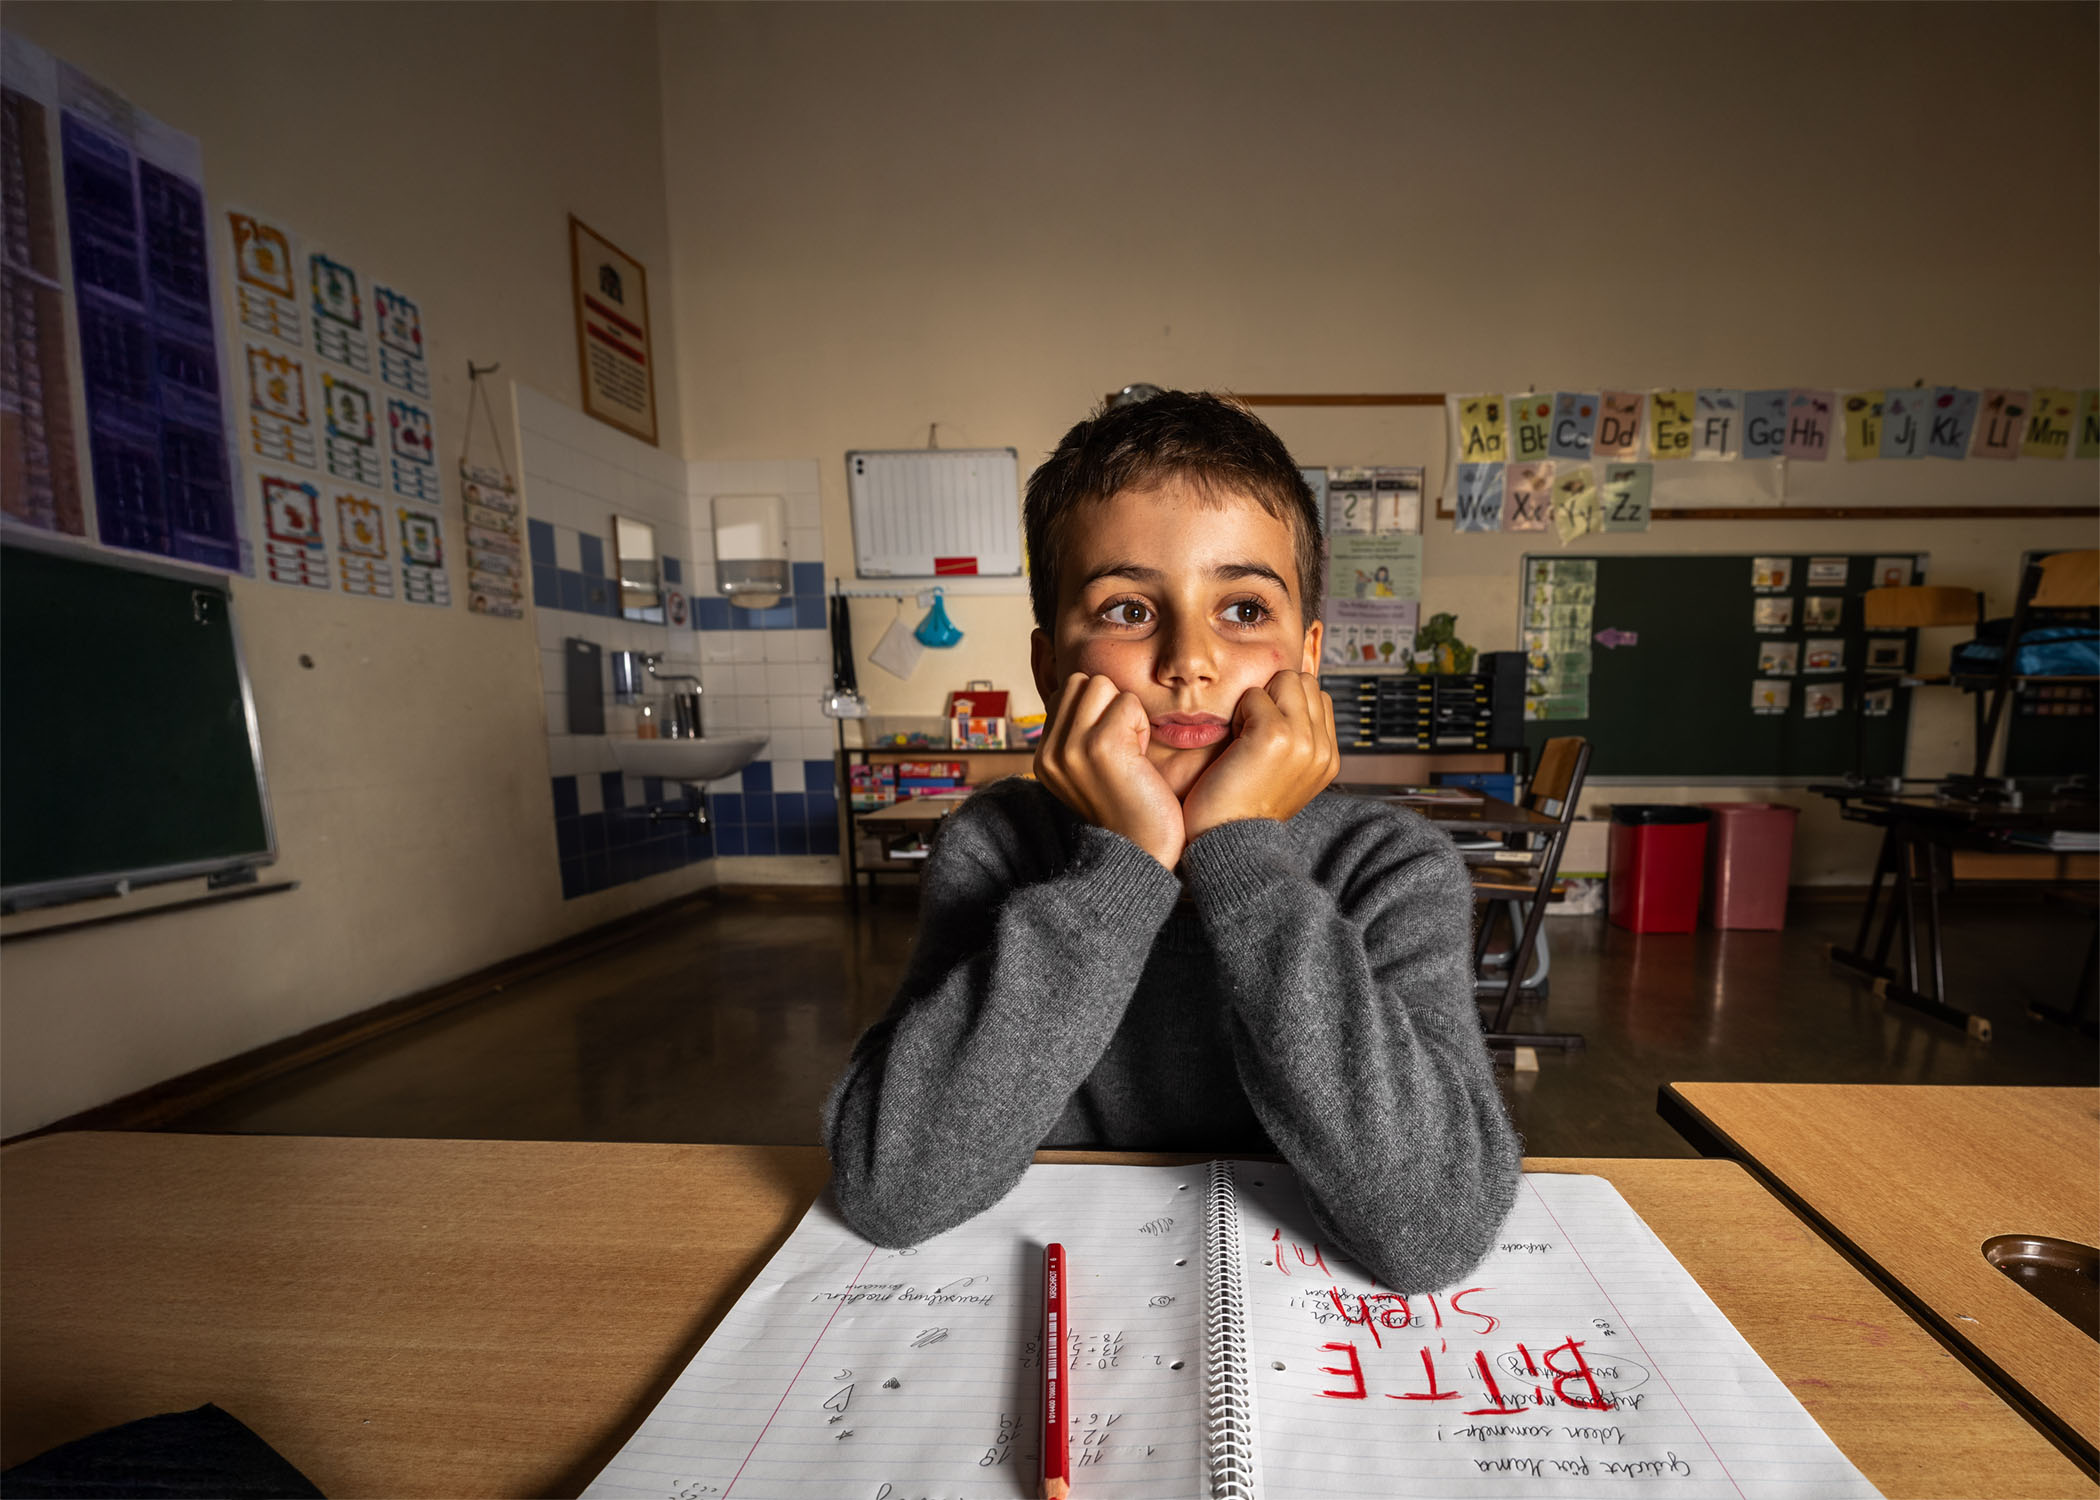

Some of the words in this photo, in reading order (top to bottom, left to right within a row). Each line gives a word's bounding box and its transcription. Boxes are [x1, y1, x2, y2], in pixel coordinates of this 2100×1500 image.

[1467, 424, 1500, 454] Aa
[1556, 419, 1590, 450] Cc
[1600, 417, 1636, 447] Dd
[1657, 420, 1689, 450] Ee
[1704, 417, 1731, 455] Ff
[1790, 416, 1825, 448] Hh
[1895, 415, 1917, 455] Jj
[1930, 415, 1964, 447] Kk
[2027, 415, 2070, 446] Mm
[1610, 492, 1642, 522] Zz
[1312, 1300, 1330, 1310] 82
[1103, 1331, 1123, 1344] 18
[1103, 1343, 1124, 1357] 13
[1097, 1356, 1119, 1370] 20
[999, 1414, 1023, 1429] 19
[996, 1430, 1020, 1445] 19
[1083, 1429, 1110, 1446] 12
[979, 1446, 1010, 1467] 19
[1078, 1448, 1103, 1467] 14
[1600, 1452, 1691, 1478] Gedicht
[1474, 1458, 1545, 1477] Mama
[1549, 1456, 1590, 1477] für
